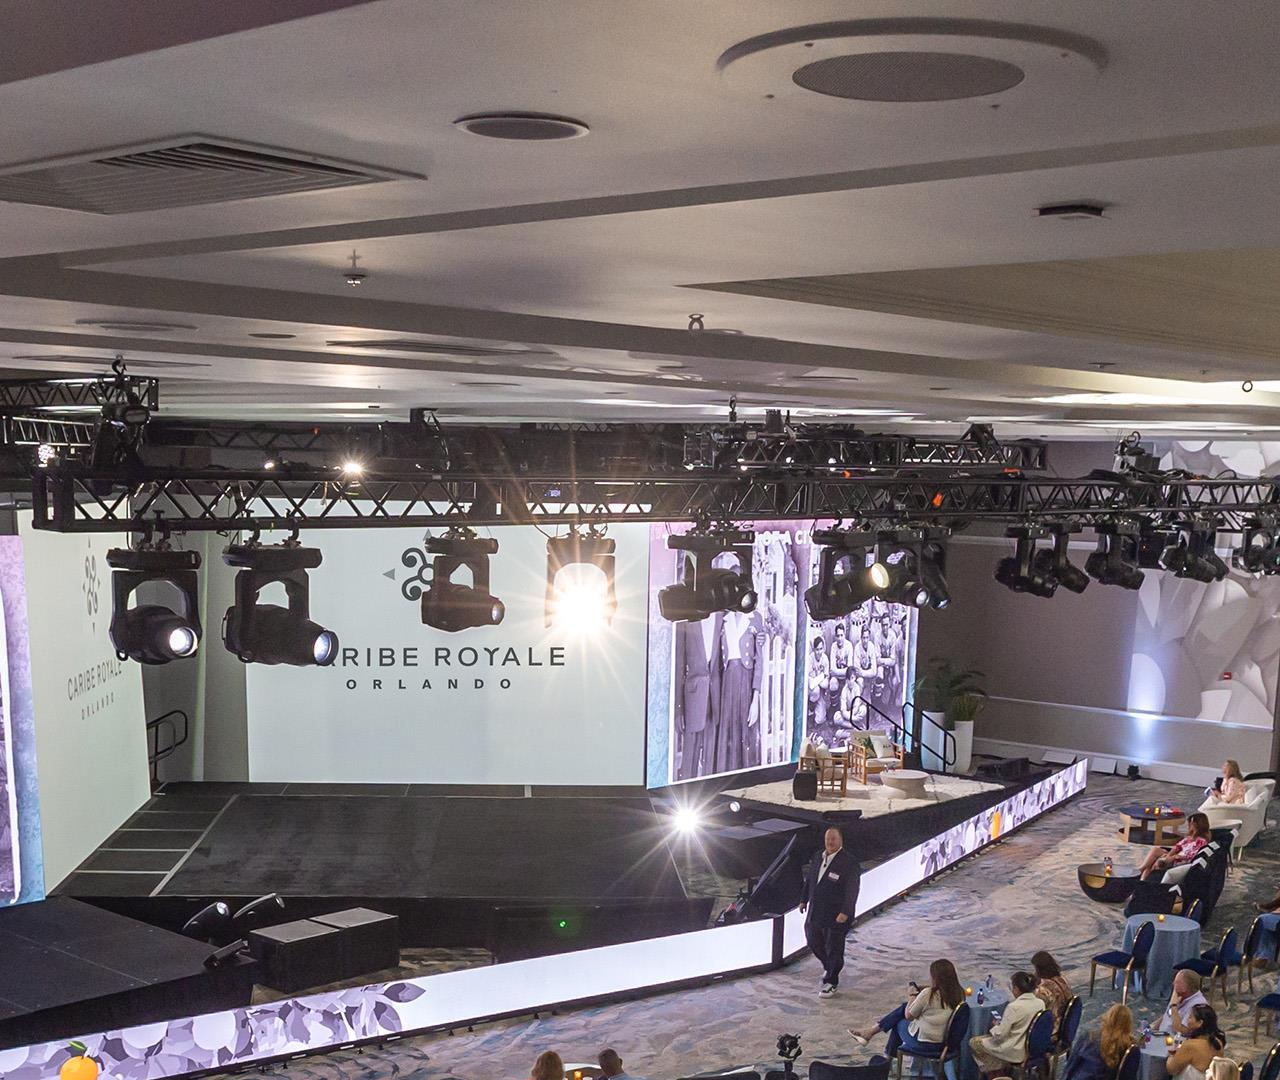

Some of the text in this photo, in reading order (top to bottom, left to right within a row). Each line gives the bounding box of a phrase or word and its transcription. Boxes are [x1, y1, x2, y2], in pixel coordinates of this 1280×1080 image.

[316, 646, 566, 667] RIBE ROYALE
[67, 667, 96, 702] CARIBE
[345, 678, 512, 690] ORLANDO
